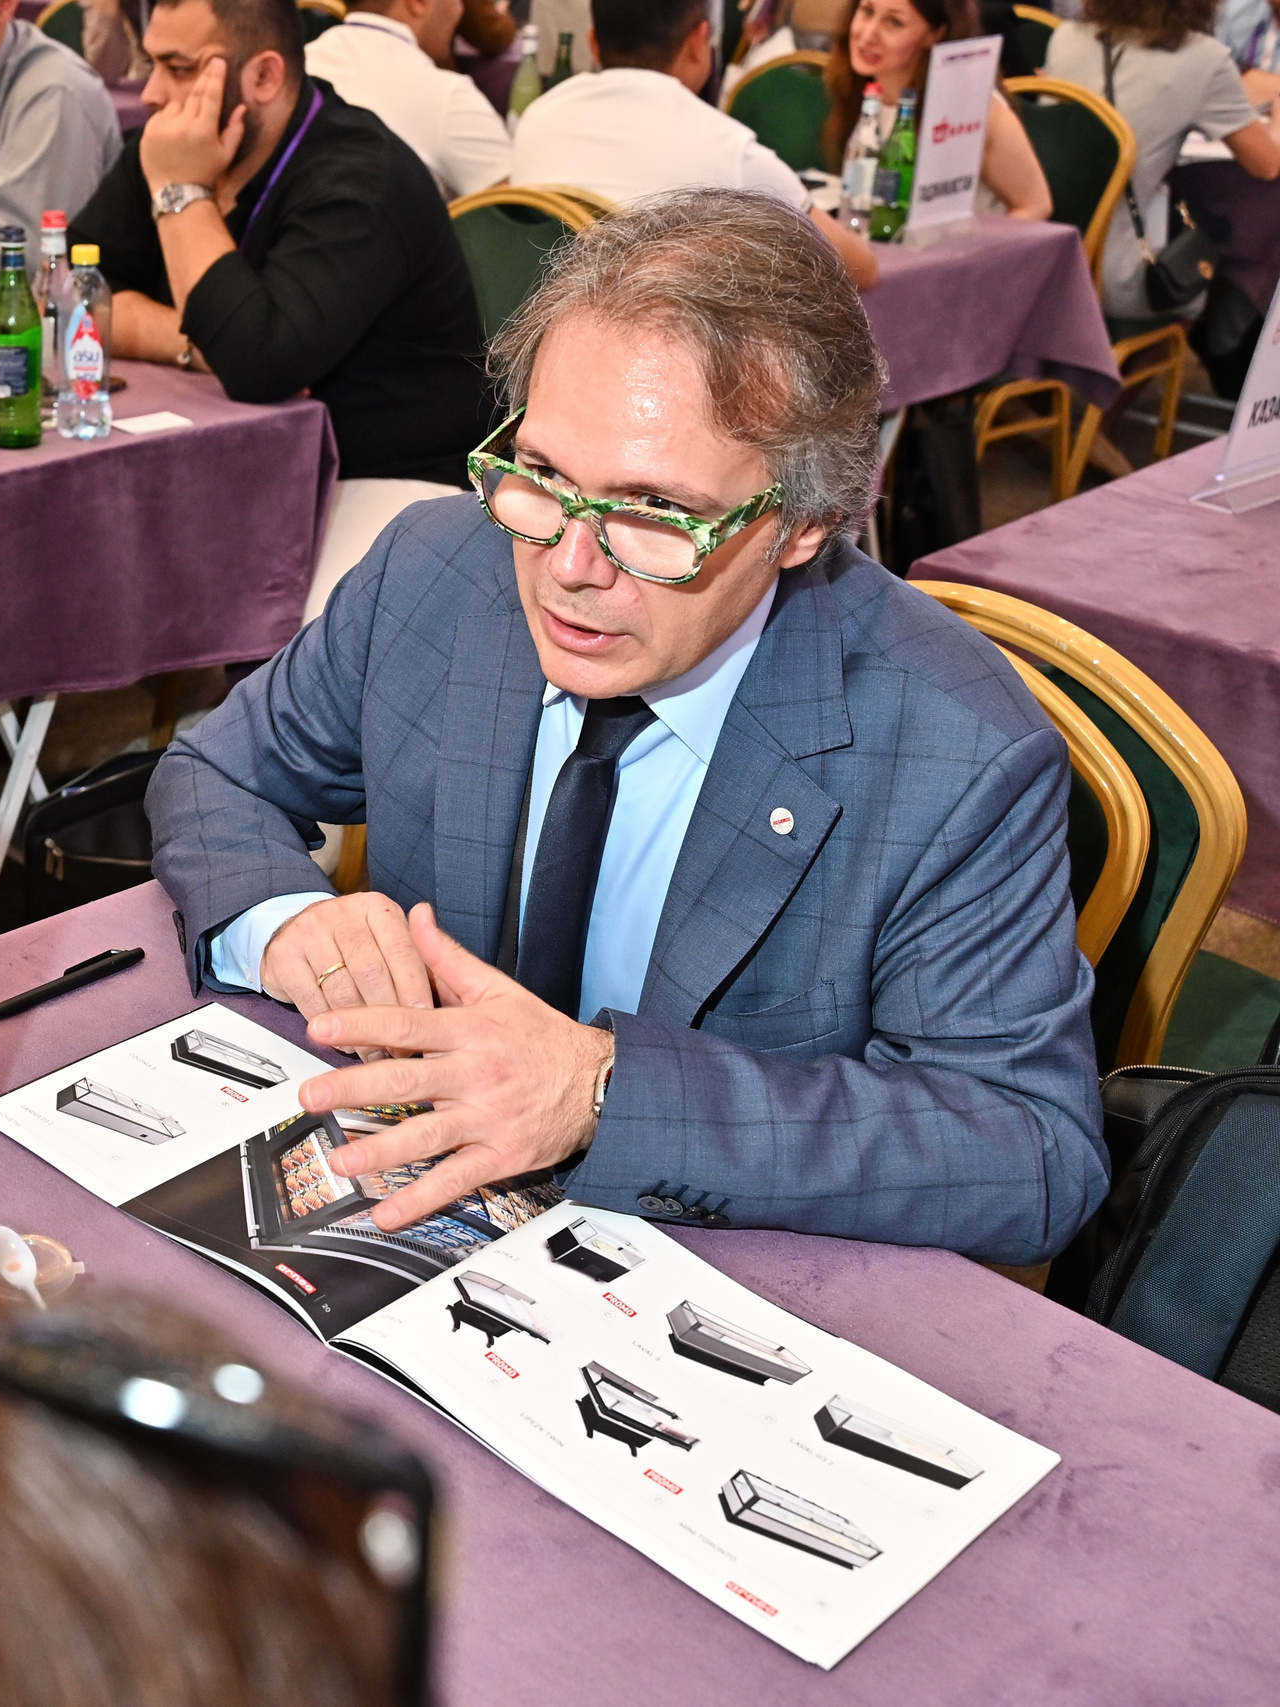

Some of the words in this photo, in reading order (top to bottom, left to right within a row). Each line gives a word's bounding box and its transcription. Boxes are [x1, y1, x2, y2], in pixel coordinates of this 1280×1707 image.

[223, 1087, 246, 1102] PROMO
[321, 1303, 331, 1313] 20
[604, 1294, 634, 1316] PROMO
[487, 1353, 517, 1378] PROMO
[647, 1470, 680, 1494] PROMO
